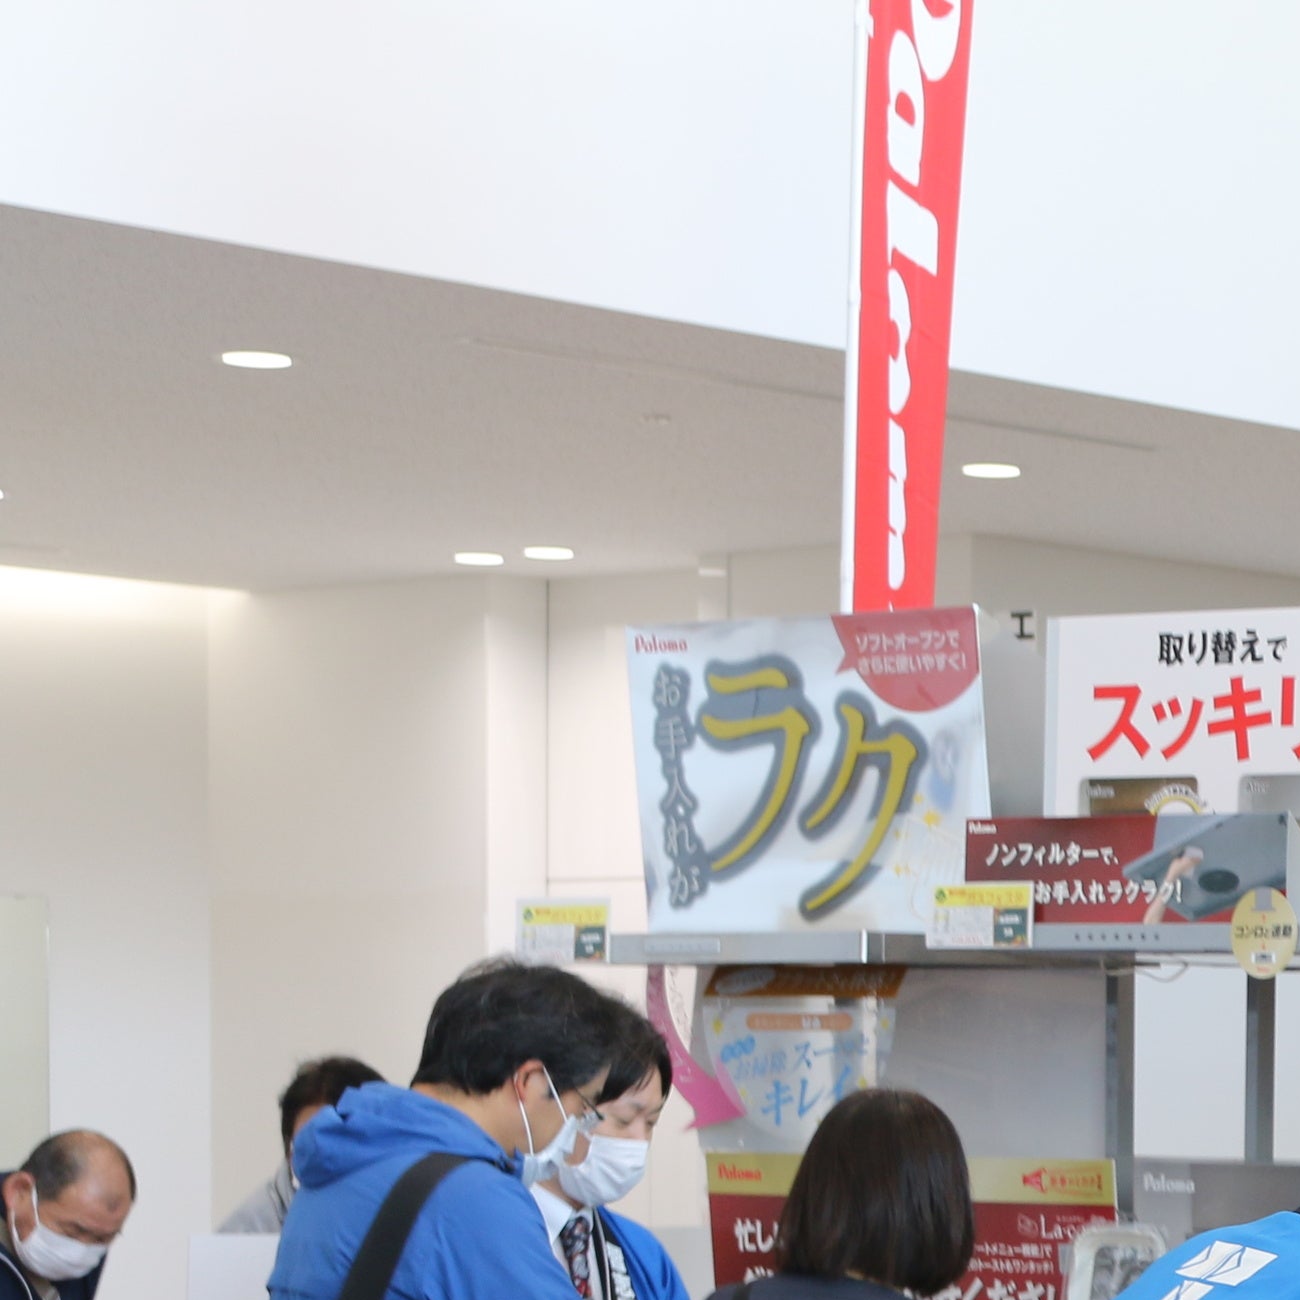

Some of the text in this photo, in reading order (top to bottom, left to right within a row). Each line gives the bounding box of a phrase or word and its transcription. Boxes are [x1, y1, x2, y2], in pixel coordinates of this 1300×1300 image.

[634, 635, 688, 654] Paloma
[1158, 628, 1289, 667] 取り替えで
[717, 1163, 762, 1181] Paloma
[1143, 1173, 1196, 1195] Paloma
